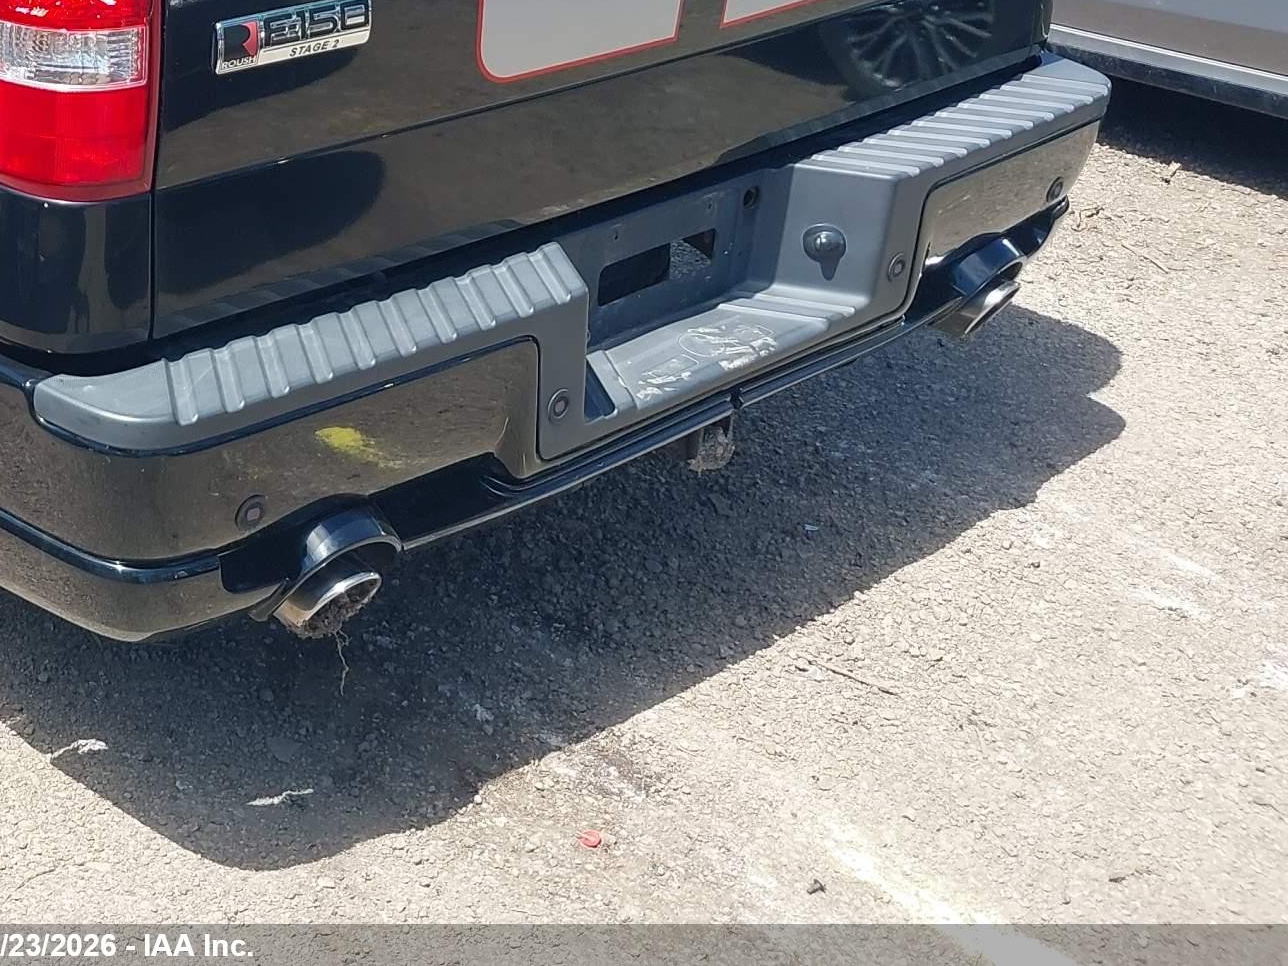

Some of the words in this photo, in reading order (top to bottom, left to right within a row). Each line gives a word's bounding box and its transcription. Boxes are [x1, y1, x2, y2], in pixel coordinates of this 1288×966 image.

[289, 40, 330, 57] STAGE
[333, 38, 340, 49] 2
[221, 55, 258, 70] ROUSH
